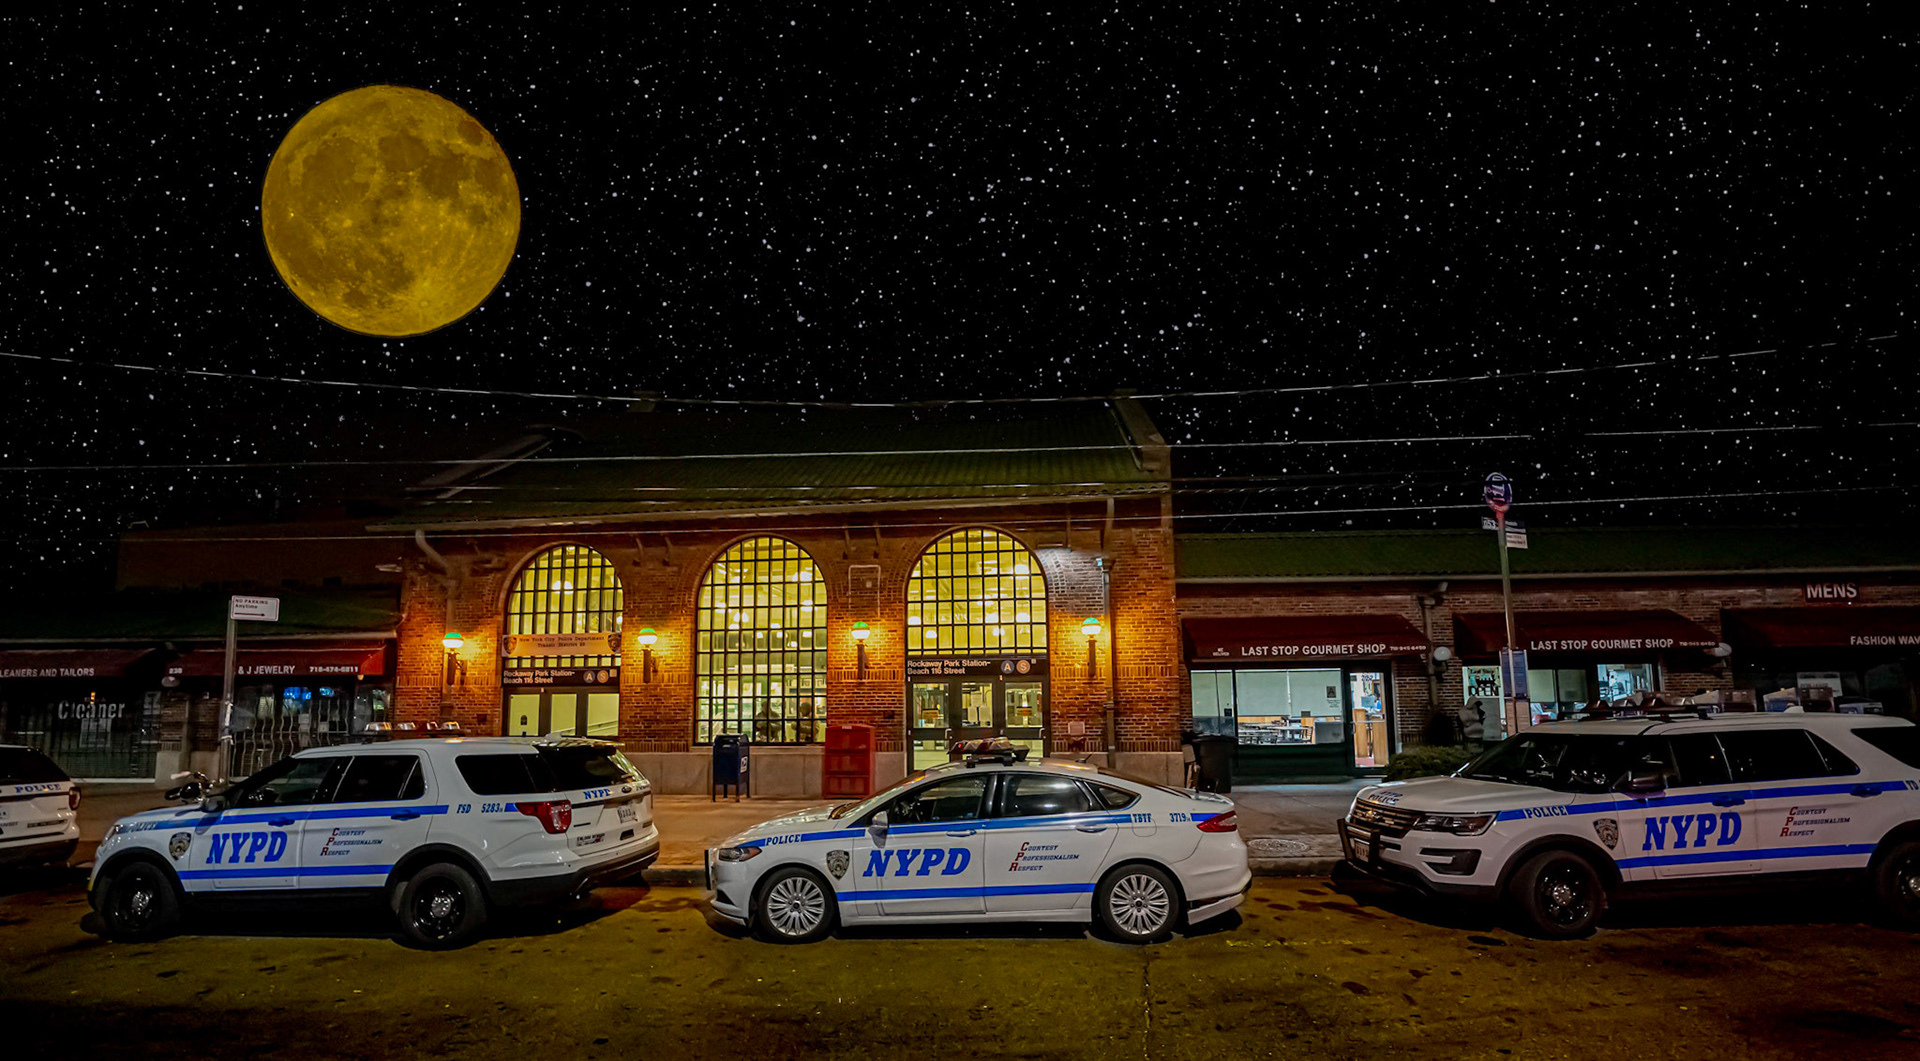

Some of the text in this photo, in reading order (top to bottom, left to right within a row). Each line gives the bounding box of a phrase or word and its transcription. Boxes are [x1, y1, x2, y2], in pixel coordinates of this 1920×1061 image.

[1806, 583, 1858, 598] MENS
[1530, 641, 1558, 650] LAST
[1561, 640, 1588, 650] STOP
[1591, 639, 1642, 649] GOURMET
[1645, 638, 1674, 648] SHOP
[1850, 636, 1896, 645] FASHION
[1241, 646, 1269, 656] LAST
[1271, 645, 1299, 655] STOP
[1302, 645, 1354, 655] GOURMET
[1357, 643, 1386, 654] SHOP
[238, 665, 244, 674] &
[246, 665, 252, 674] J
[254, 665, 296, 674] JEWELRY
[908, 660, 942, 669] Rockaway
[40, 668, 58, 677] AND
[60, 667, 95, 677] TAILORS
[504, 670, 534, 678] Rockaway
[944, 667, 966, 675] Street
[535, 676, 554, 684] Street
[1468, 685, 1500, 697] OPEN
[15, 783, 61, 793] POLICE
[583, 788, 612, 800] NYPD
[481, 802, 500, 813] 5283
[1525, 805, 1567, 818] POLICE
[1169, 812, 1186, 822] 3719
[1642, 812, 1742, 851] NYPD
[765, 834, 802, 846] POLICE
[206, 831, 287, 864] NYPD
[863, 848, 971, 877] NYPD
